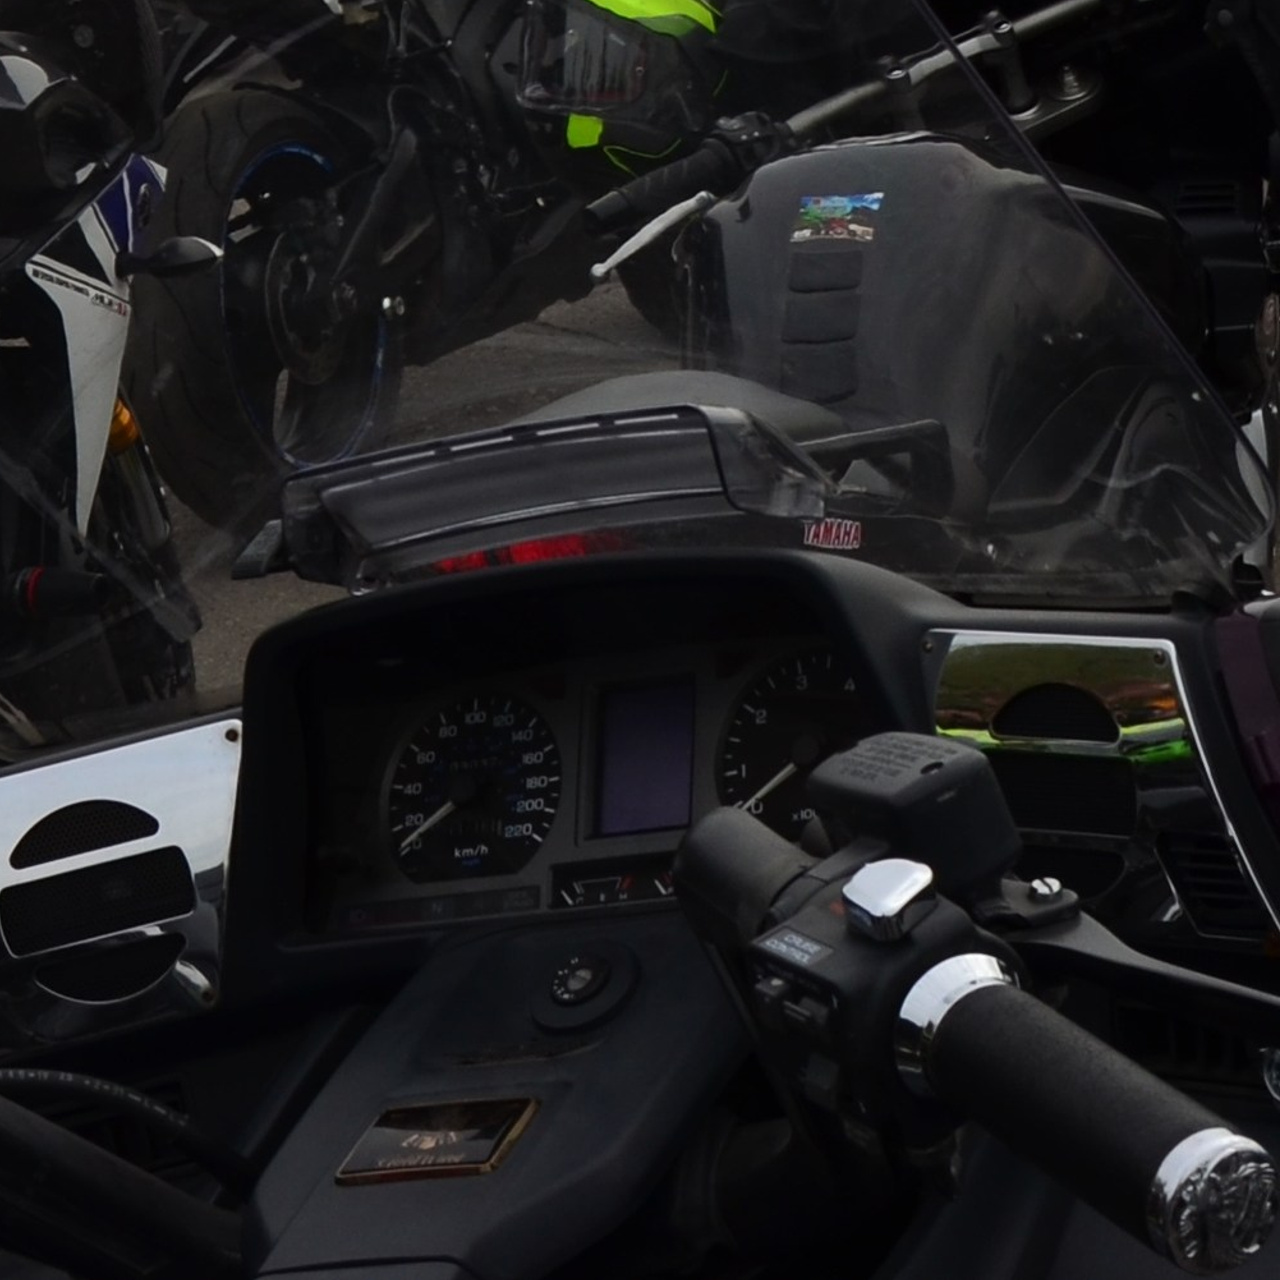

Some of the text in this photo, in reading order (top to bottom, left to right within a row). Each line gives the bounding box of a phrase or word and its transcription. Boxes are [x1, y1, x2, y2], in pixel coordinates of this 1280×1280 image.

[802, 518, 861, 550] YAMAHA
[796, 674, 808, 691] 3
[844, 677, 856, 692] 4
[464, 711, 487, 725] 100
[492, 713, 515, 727] 120
[755, 708, 768, 725] 2
[438, 724, 458, 738] 80
[511, 728, 534, 742] 140
[416, 750, 436, 764] 60
[522, 750, 545, 764] 160
[403, 782, 423, 795] 40
[525, 775, 548, 790] 180
[516, 798, 545, 813] 200
[750, 799, 764, 815] 0
[404, 813, 424, 827] 20
[504, 822, 533, 838] 220
[453, 844, 489, 858] km/h
